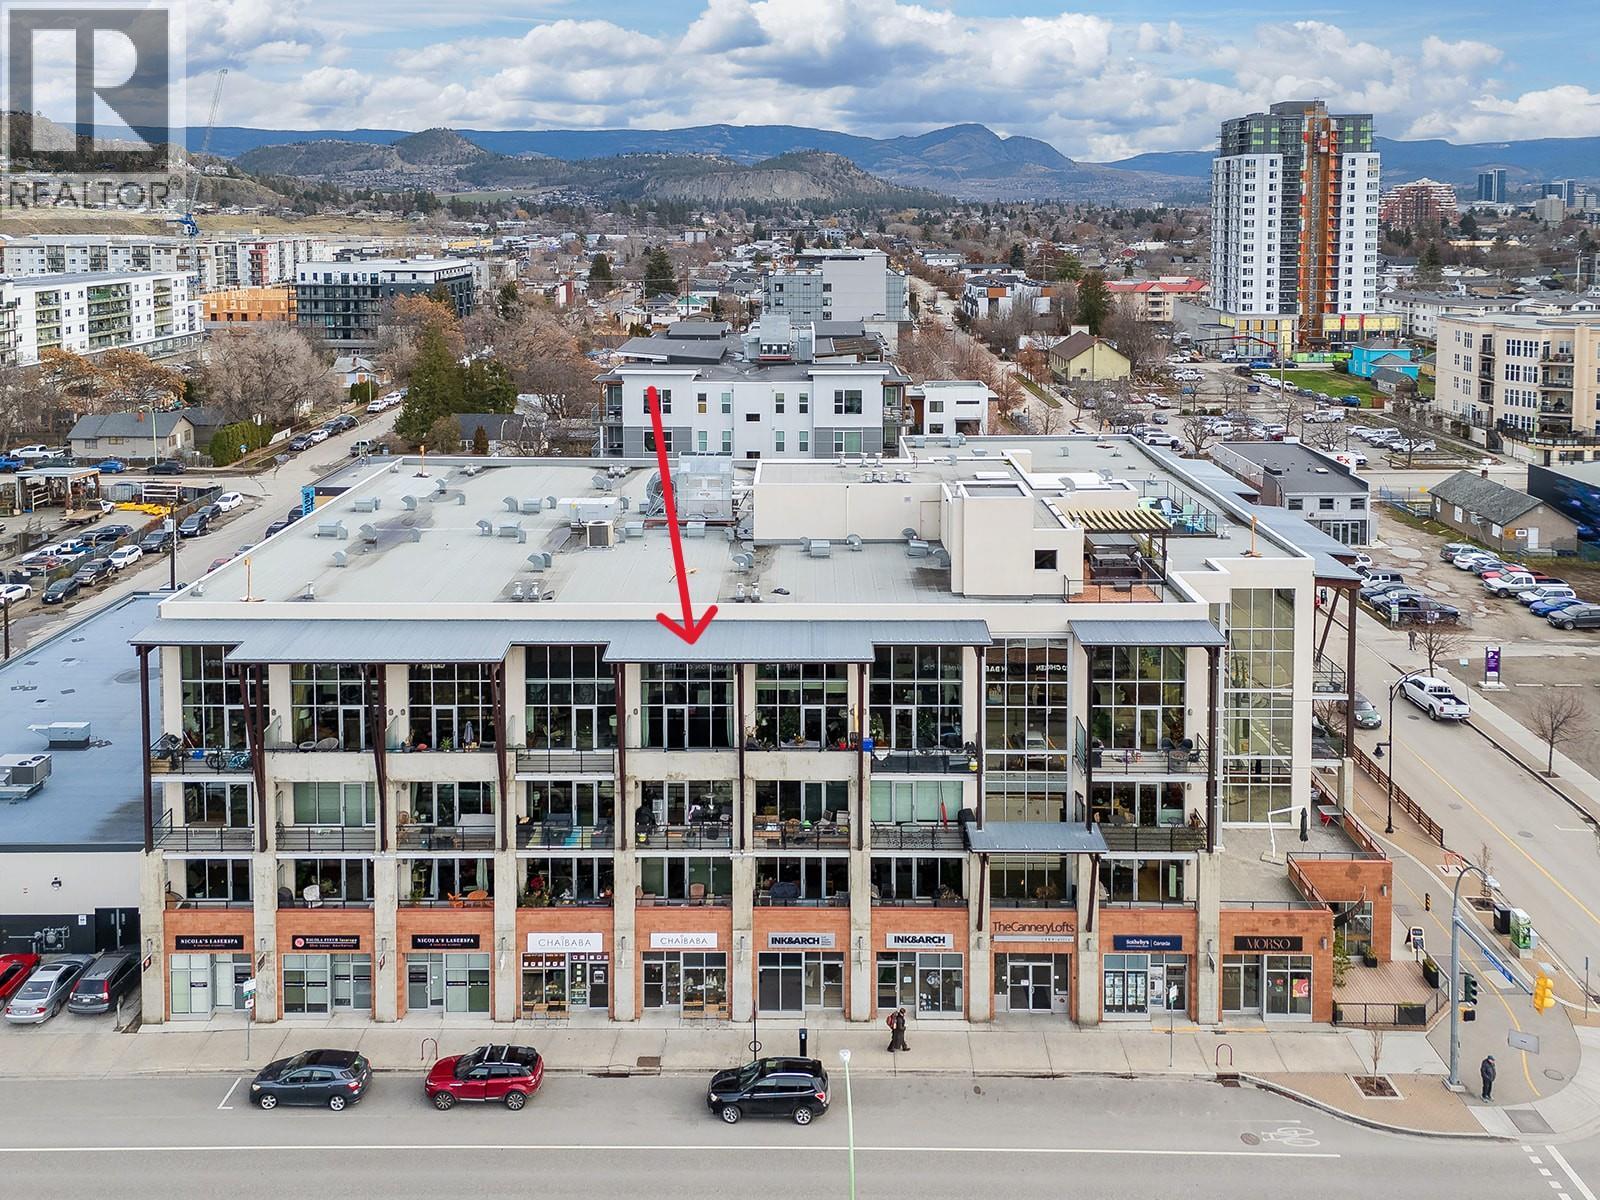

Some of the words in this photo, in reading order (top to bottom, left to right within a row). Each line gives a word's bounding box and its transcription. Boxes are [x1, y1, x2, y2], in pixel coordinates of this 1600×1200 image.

[771, 936, 820, 945] INK&ARCH
[893, 935, 946, 944] INK&ARCH
[1247, 938, 1291, 949] MORSO
